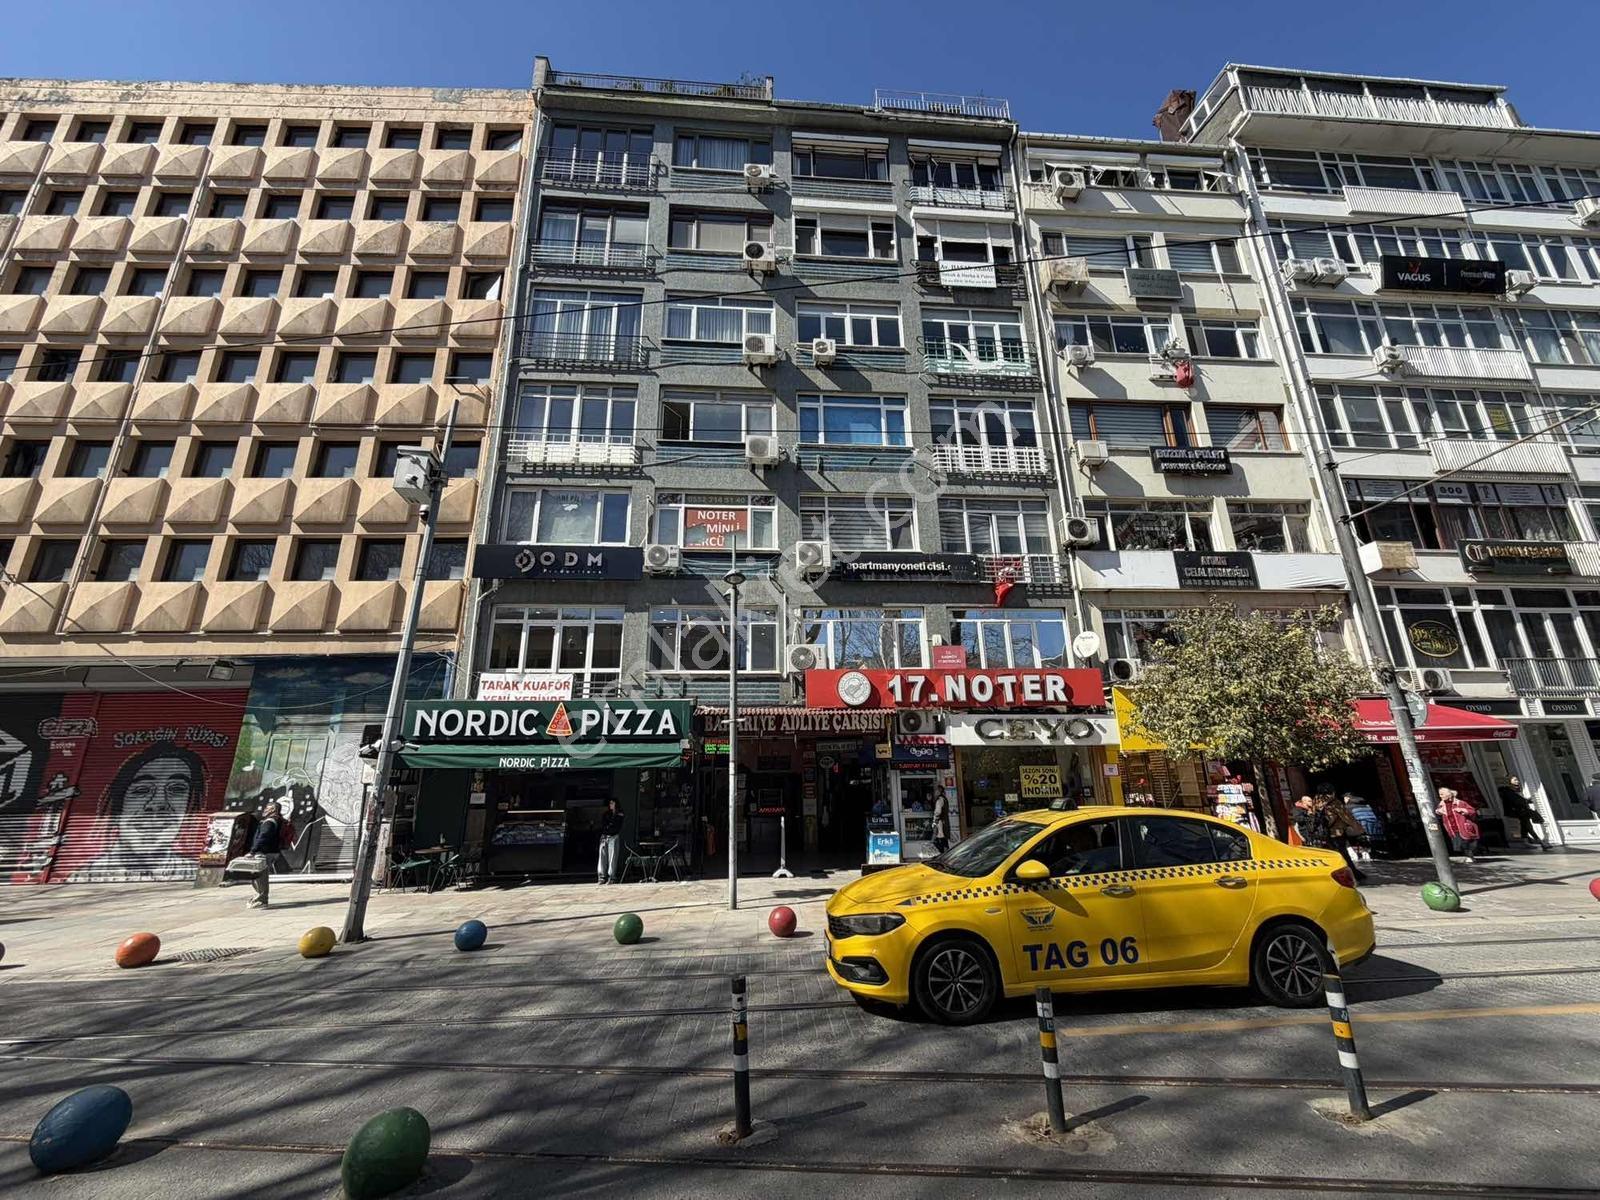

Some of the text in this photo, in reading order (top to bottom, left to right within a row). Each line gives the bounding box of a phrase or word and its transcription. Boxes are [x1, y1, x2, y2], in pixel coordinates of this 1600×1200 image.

[1397, 272, 1431, 282] VAGUS
[697, 510, 736, 520] NOTER
[481, 679, 570, 691] TARAK KUAFÖR
[1466, 703, 1492, 712] OYSHO
[1552, 703, 1578, 712] OYSHO
[413, 702, 677, 736] NORDIC PİZZA
[832, 712, 885, 733] ÇARŞISI
[498, 755, 570, 768] NORDIC PİZZA
[1024, 774, 1058, 785] %20
[1022, 936, 1139, 971] TAG 06
